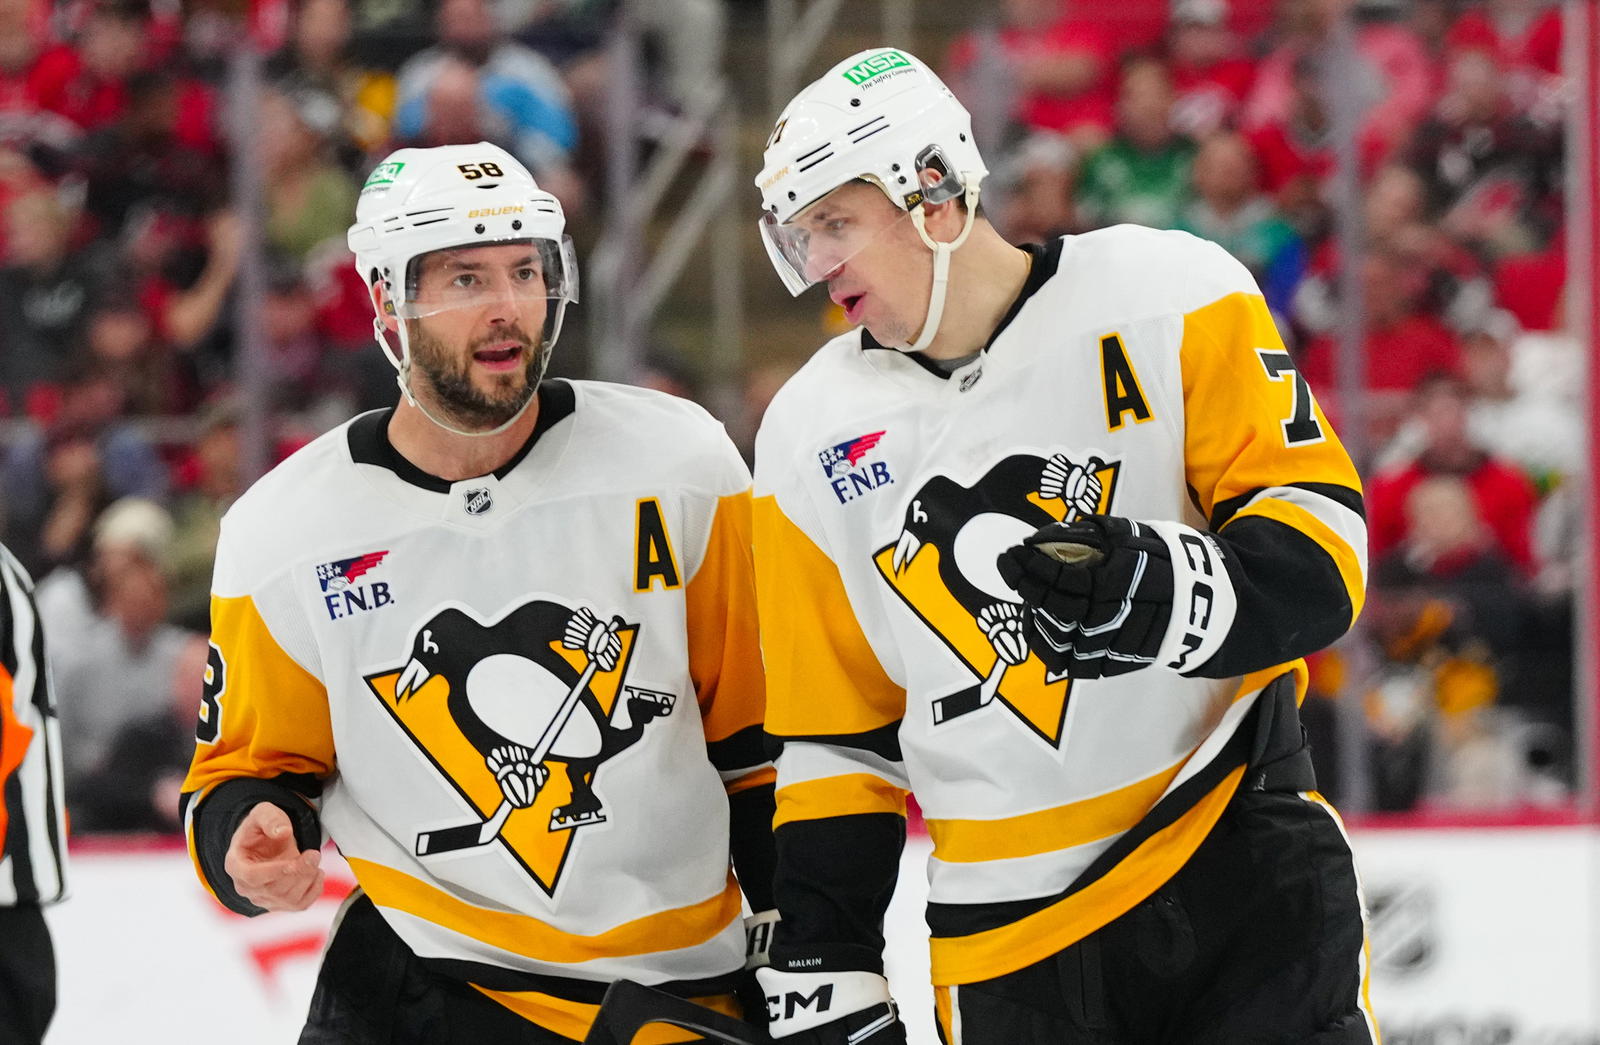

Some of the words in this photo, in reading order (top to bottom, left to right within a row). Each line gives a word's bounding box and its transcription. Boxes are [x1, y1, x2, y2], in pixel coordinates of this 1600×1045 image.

[847, 52, 907, 82] MSA
[861, 81, 873, 91] The
[873, 73, 892, 84] Safety
[457, 162, 504, 180] 58
[467, 206, 525, 219] BAUER
[1099, 331, 1155, 432] A
[1254, 348, 1326, 448] 7
[831, 461, 894, 504] F.N.B.
[633, 496, 683, 593] A
[325, 581, 395, 621] F.N.B.
[1166, 533, 1214, 670] CCM
[788, 957, 822, 968] MALKIN
